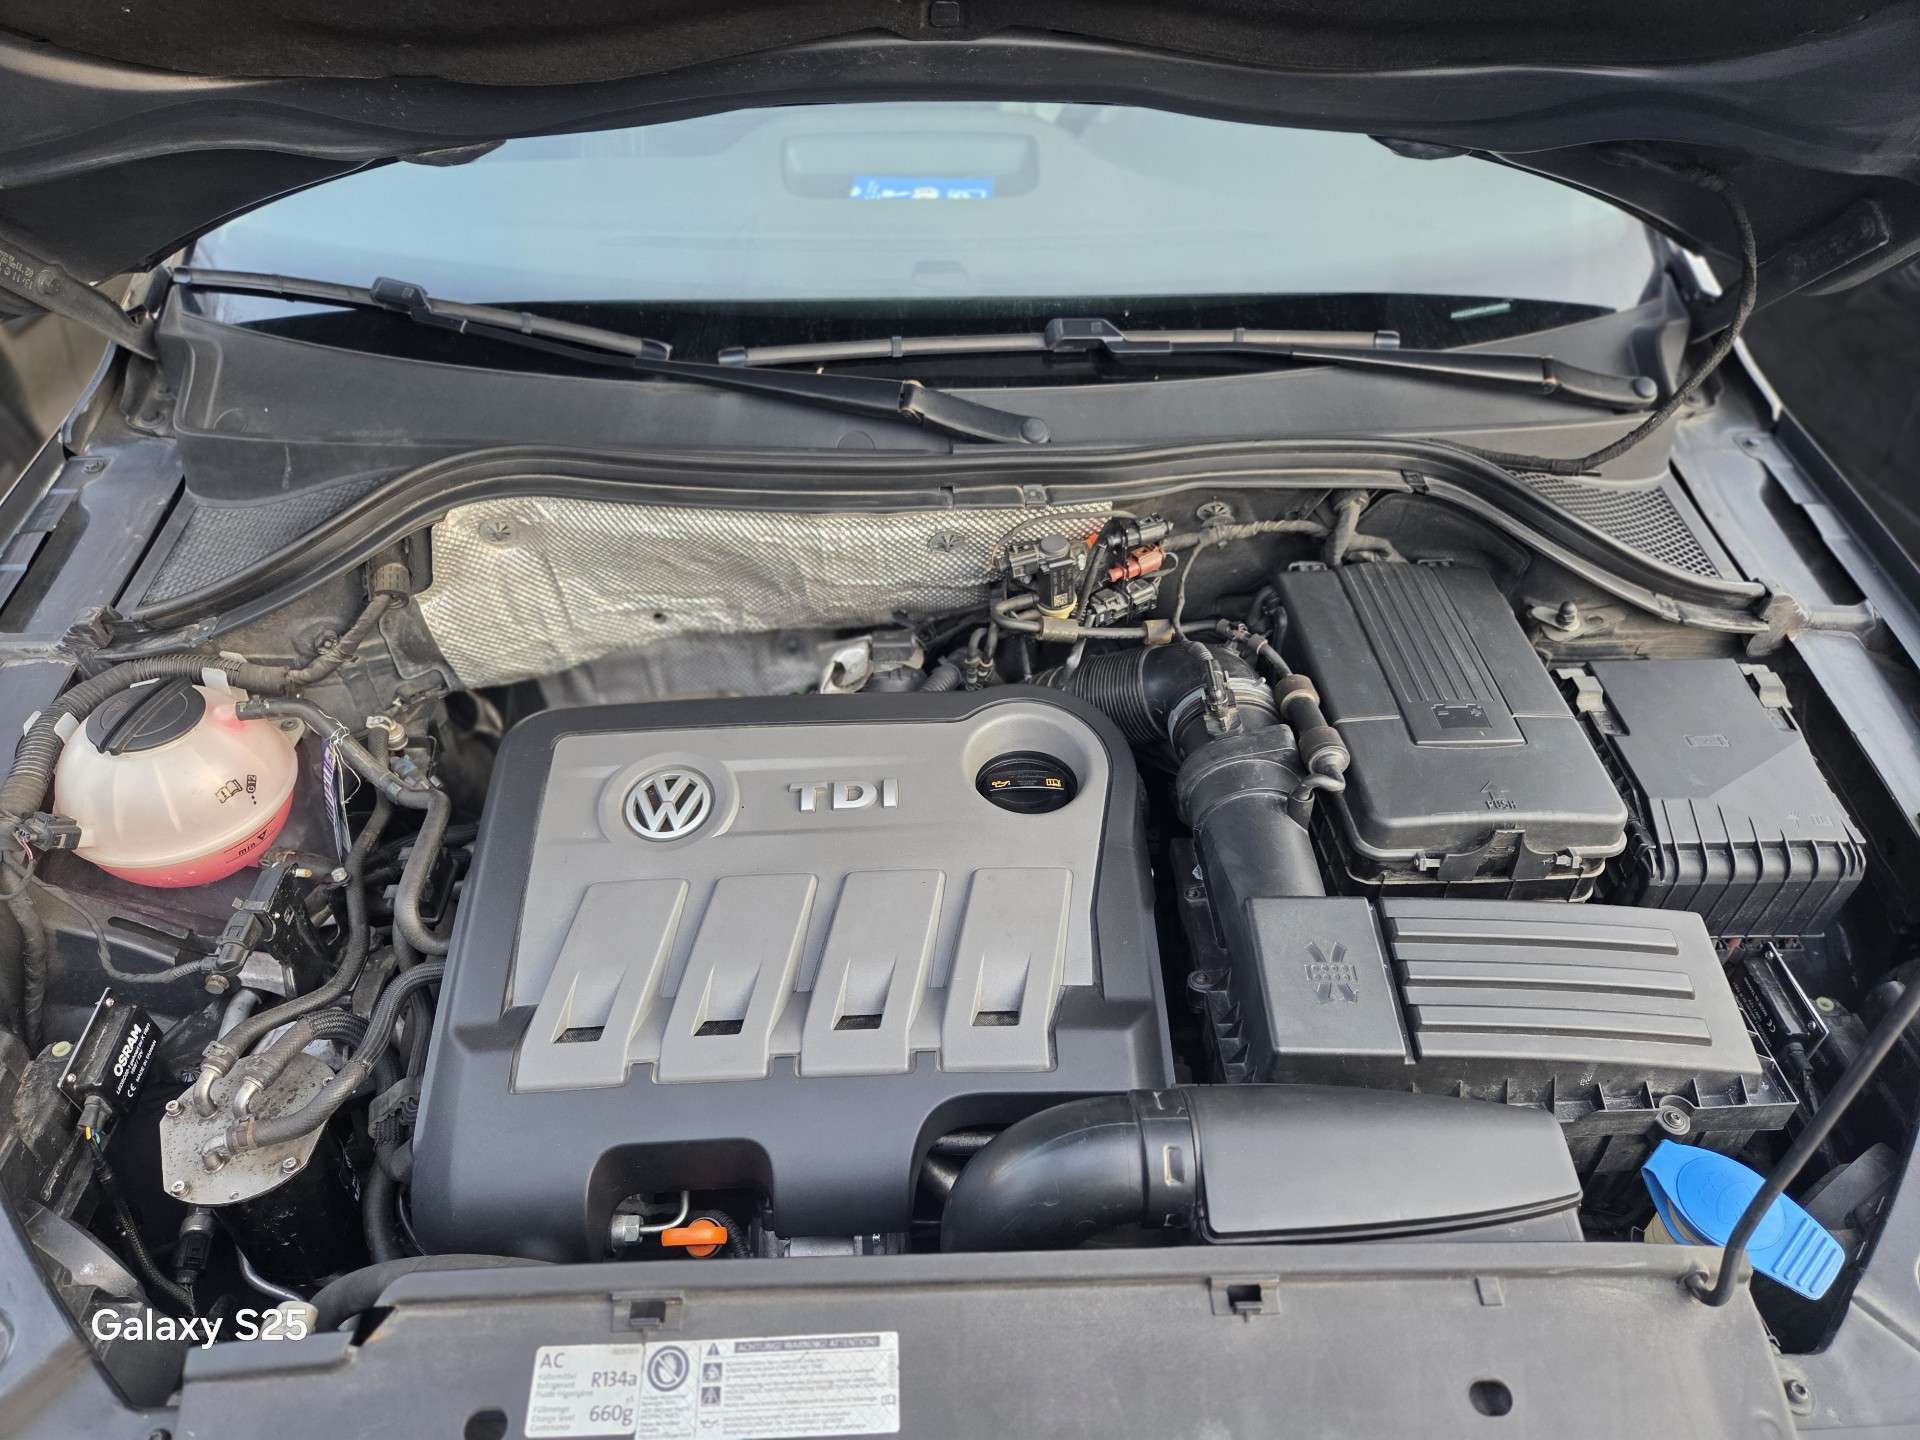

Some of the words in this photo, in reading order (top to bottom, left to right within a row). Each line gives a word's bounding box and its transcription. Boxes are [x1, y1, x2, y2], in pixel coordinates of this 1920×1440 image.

[789, 778, 900, 813] TDI
[1485, 799, 1517, 810] PUSH
[238, 842, 256, 857] min
[114, 1023, 142, 1077] OSRAM
[540, 1352, 565, 1369] AC
[591, 1370, 637, 1388] R134a
[589, 1404, 633, 1427] 660g
